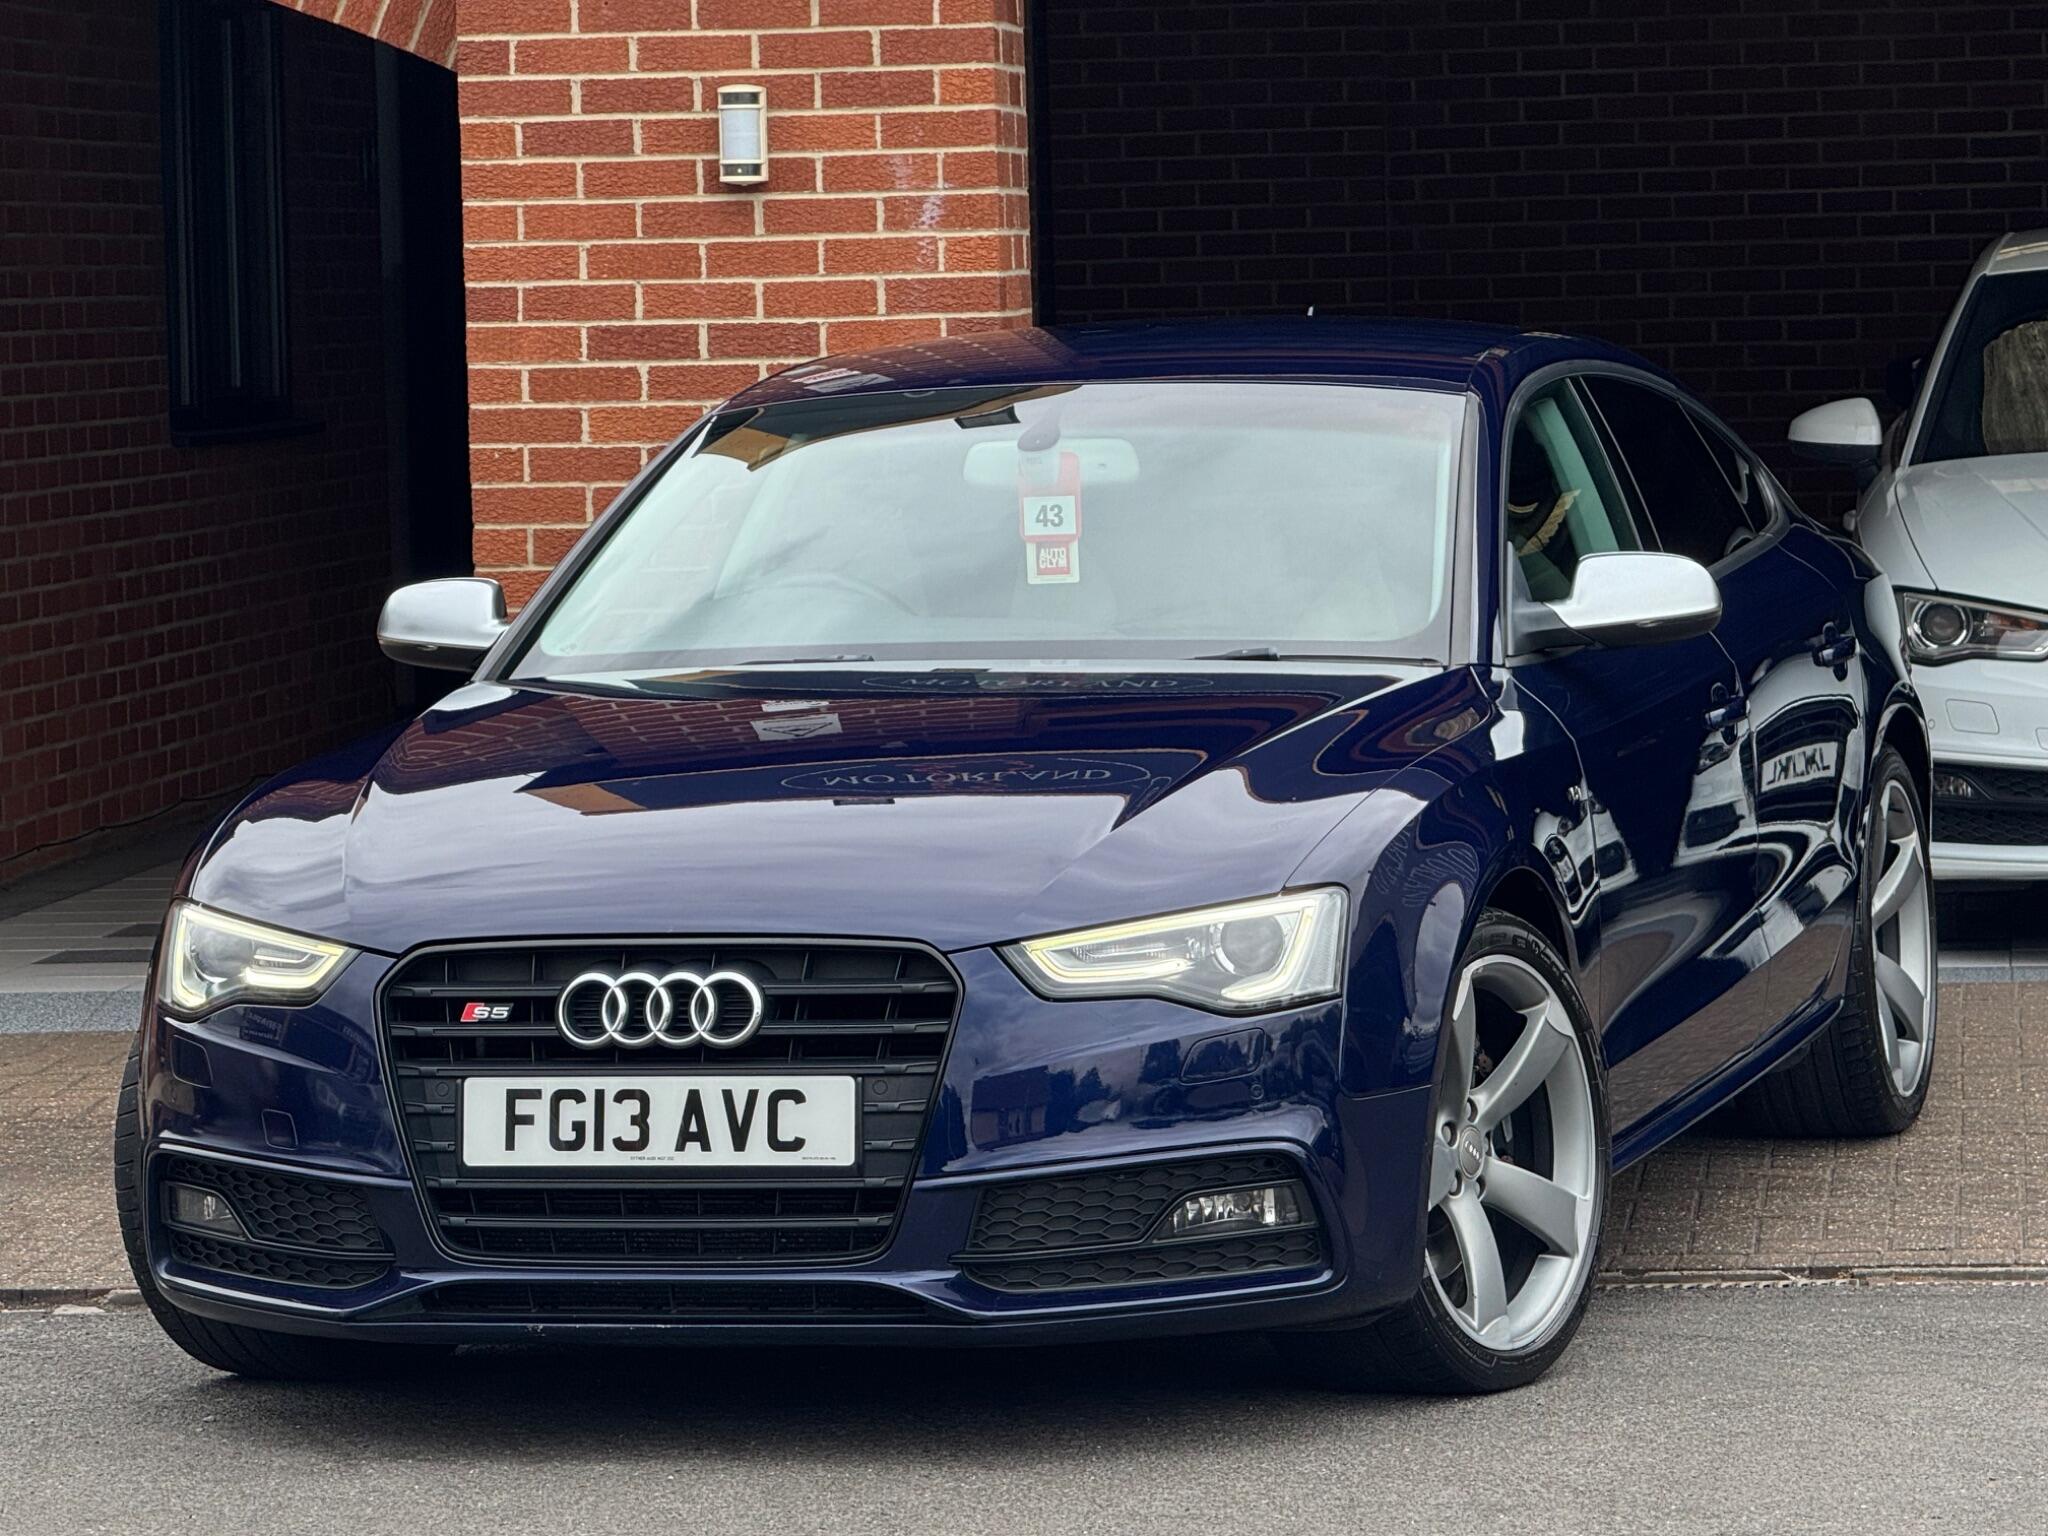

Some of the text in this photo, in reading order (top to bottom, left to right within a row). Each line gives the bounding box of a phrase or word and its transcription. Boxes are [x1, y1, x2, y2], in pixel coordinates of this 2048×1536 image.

[1035, 504, 1064, 528] 43
[472, 1006, 509, 1019] S5
[505, 1088, 807, 1152] FG13 AVC
